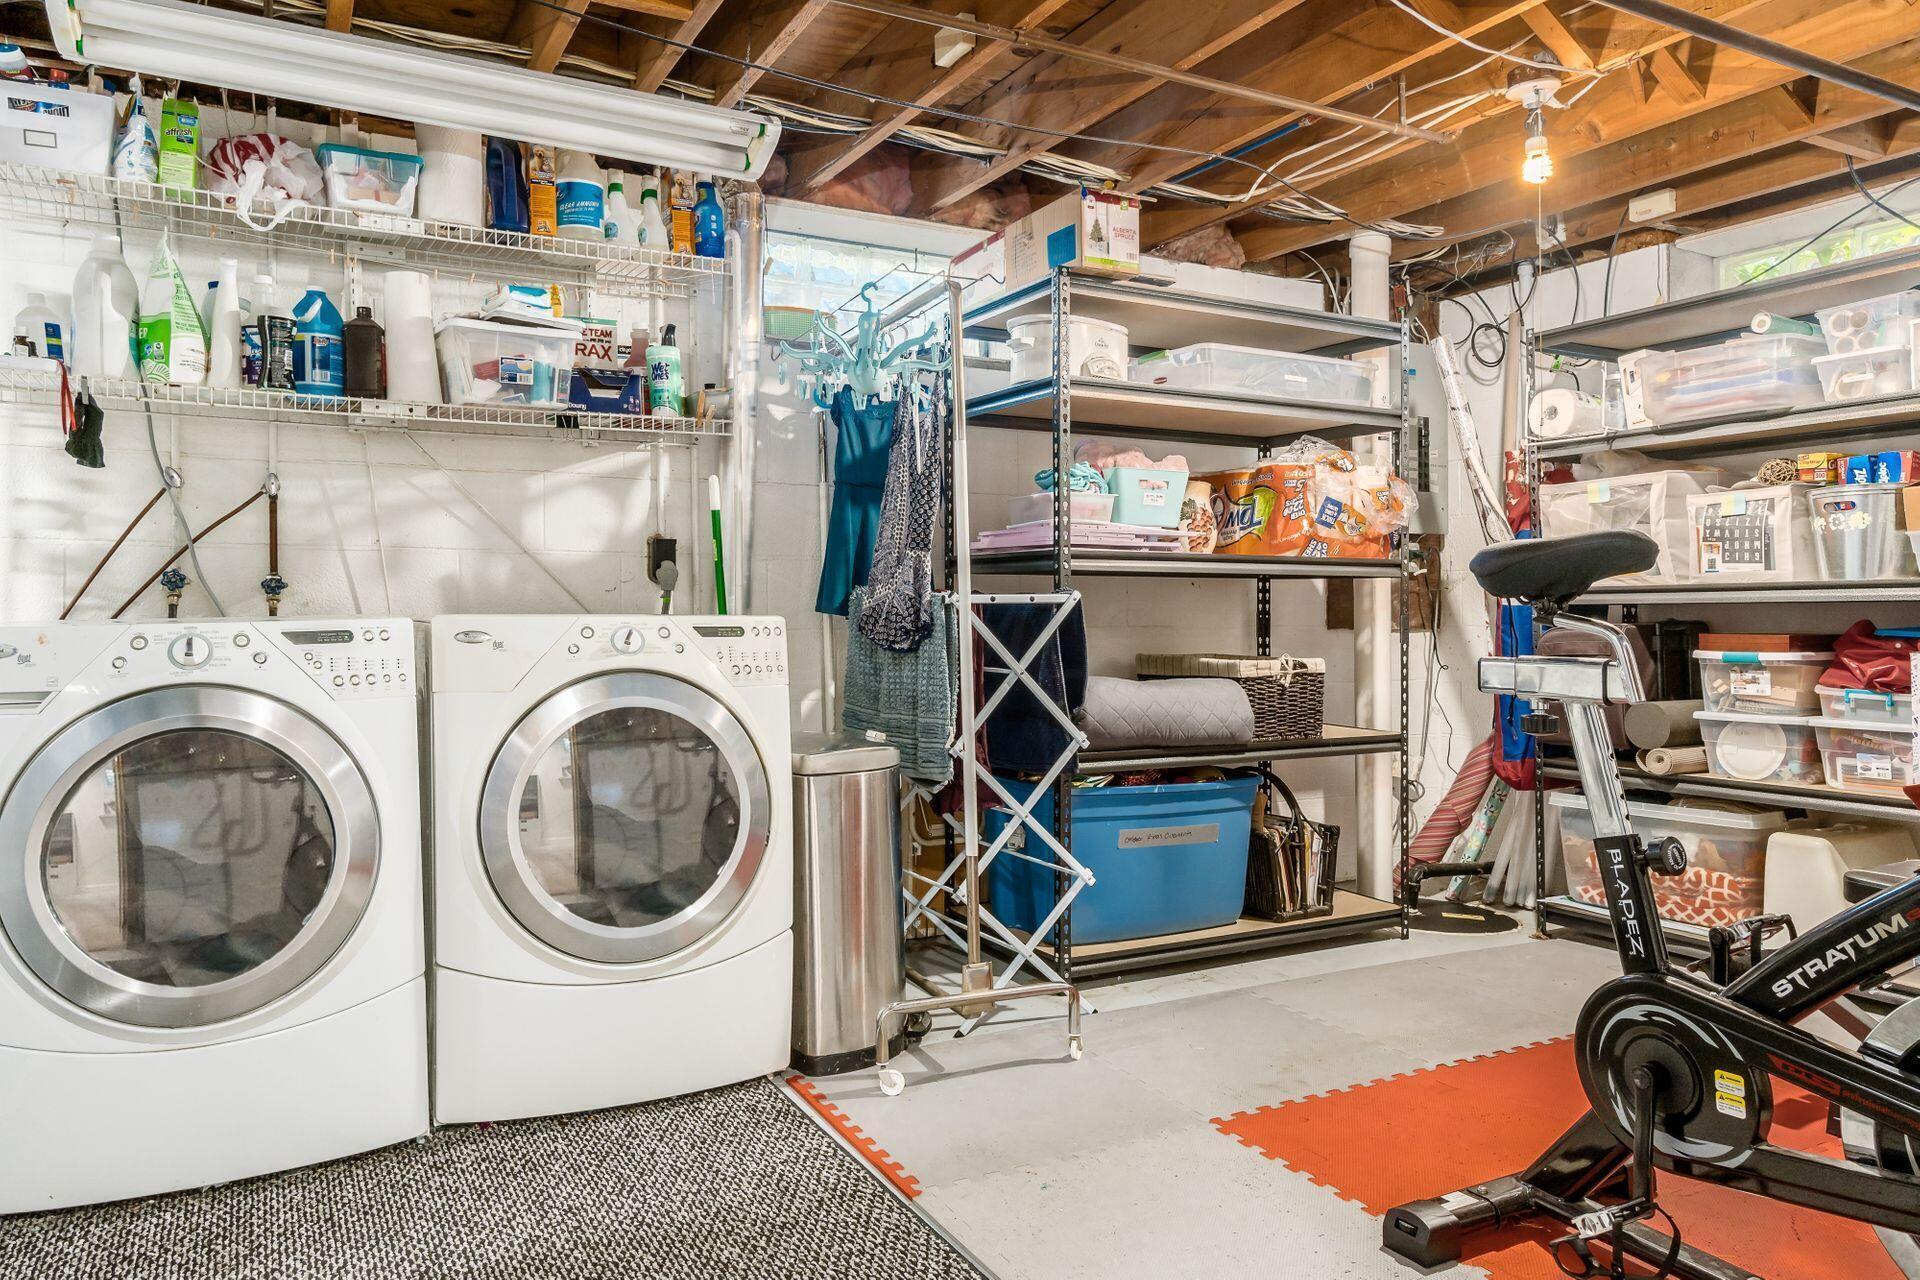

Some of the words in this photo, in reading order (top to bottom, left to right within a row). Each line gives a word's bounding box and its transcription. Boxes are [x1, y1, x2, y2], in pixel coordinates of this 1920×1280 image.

[165, 127, 193, 137] affresh
[560, 201, 575, 211] CLEAR
[1112, 226, 1137, 235] ALBERTA
[1114, 232, 1136, 241] SPRUCE
[589, 328, 612, 338] TEAM
[575, 343, 612, 362] RAX
[651, 361, 670, 374] Wet
[651, 371, 670, 382] Ones
[568, 403, 587, 411] Downy
[1608, 848, 1644, 955] BLADEZ
[1771, 912, 1909, 998] STRATUM
